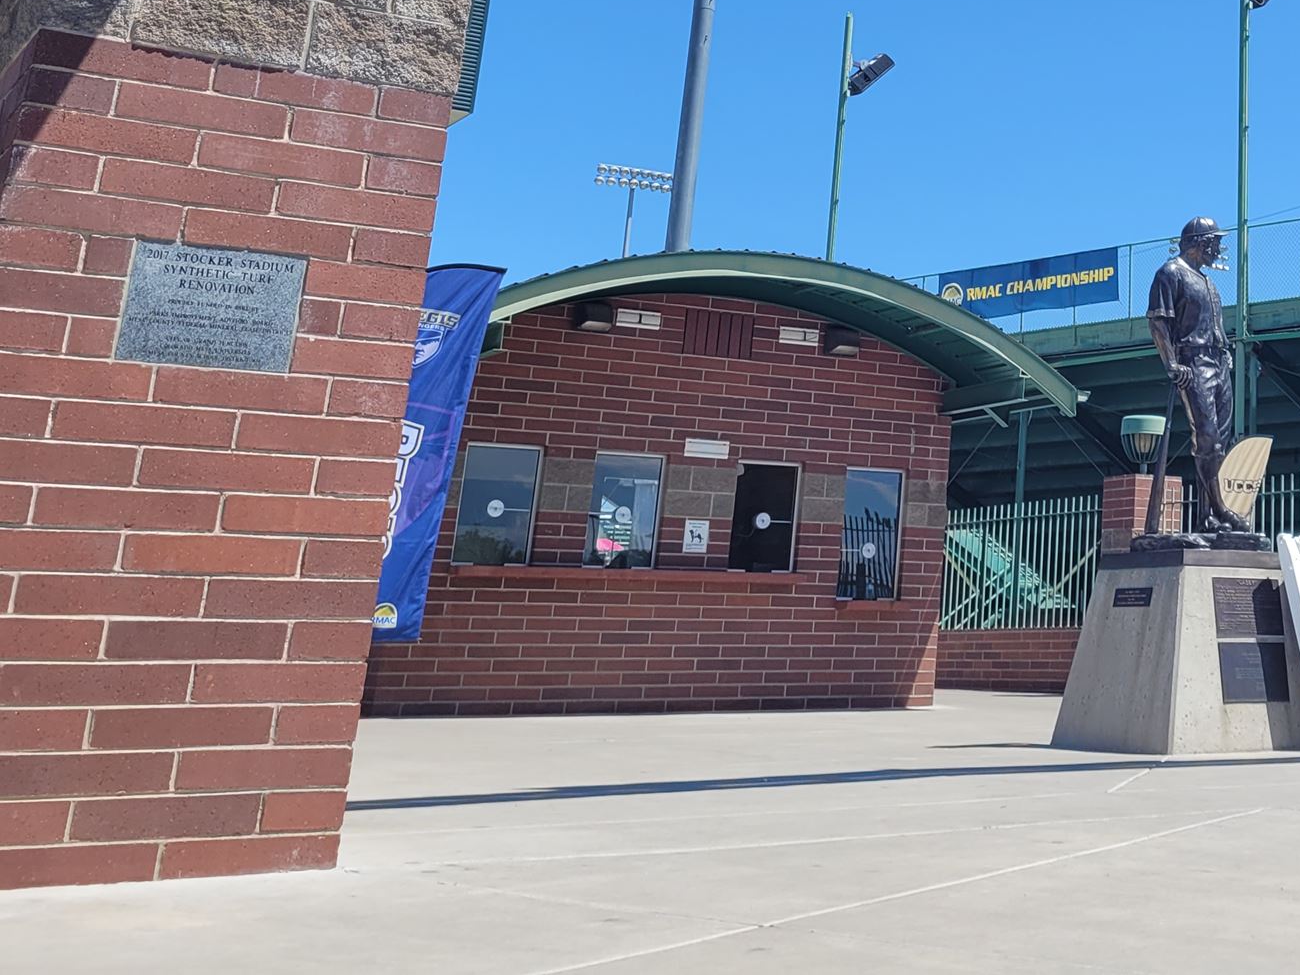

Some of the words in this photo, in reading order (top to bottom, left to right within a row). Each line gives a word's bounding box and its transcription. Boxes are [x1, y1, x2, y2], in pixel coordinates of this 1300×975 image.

[147, 249, 169, 260] 2017
[175, 253, 233, 267] STOCKER
[240, 259, 295, 274] STADIUM
[163, 264, 235, 280] SYNTHETIC
[241, 272, 276, 285] TURF
[966, 283, 1003, 302] RMAC
[1006, 266, 1114, 295] CHAMPIONSHIP
[178, 279, 256, 295] RENOVATION
[418, 322, 445, 331] NGERS
[419, 310, 459, 328] EGIS
